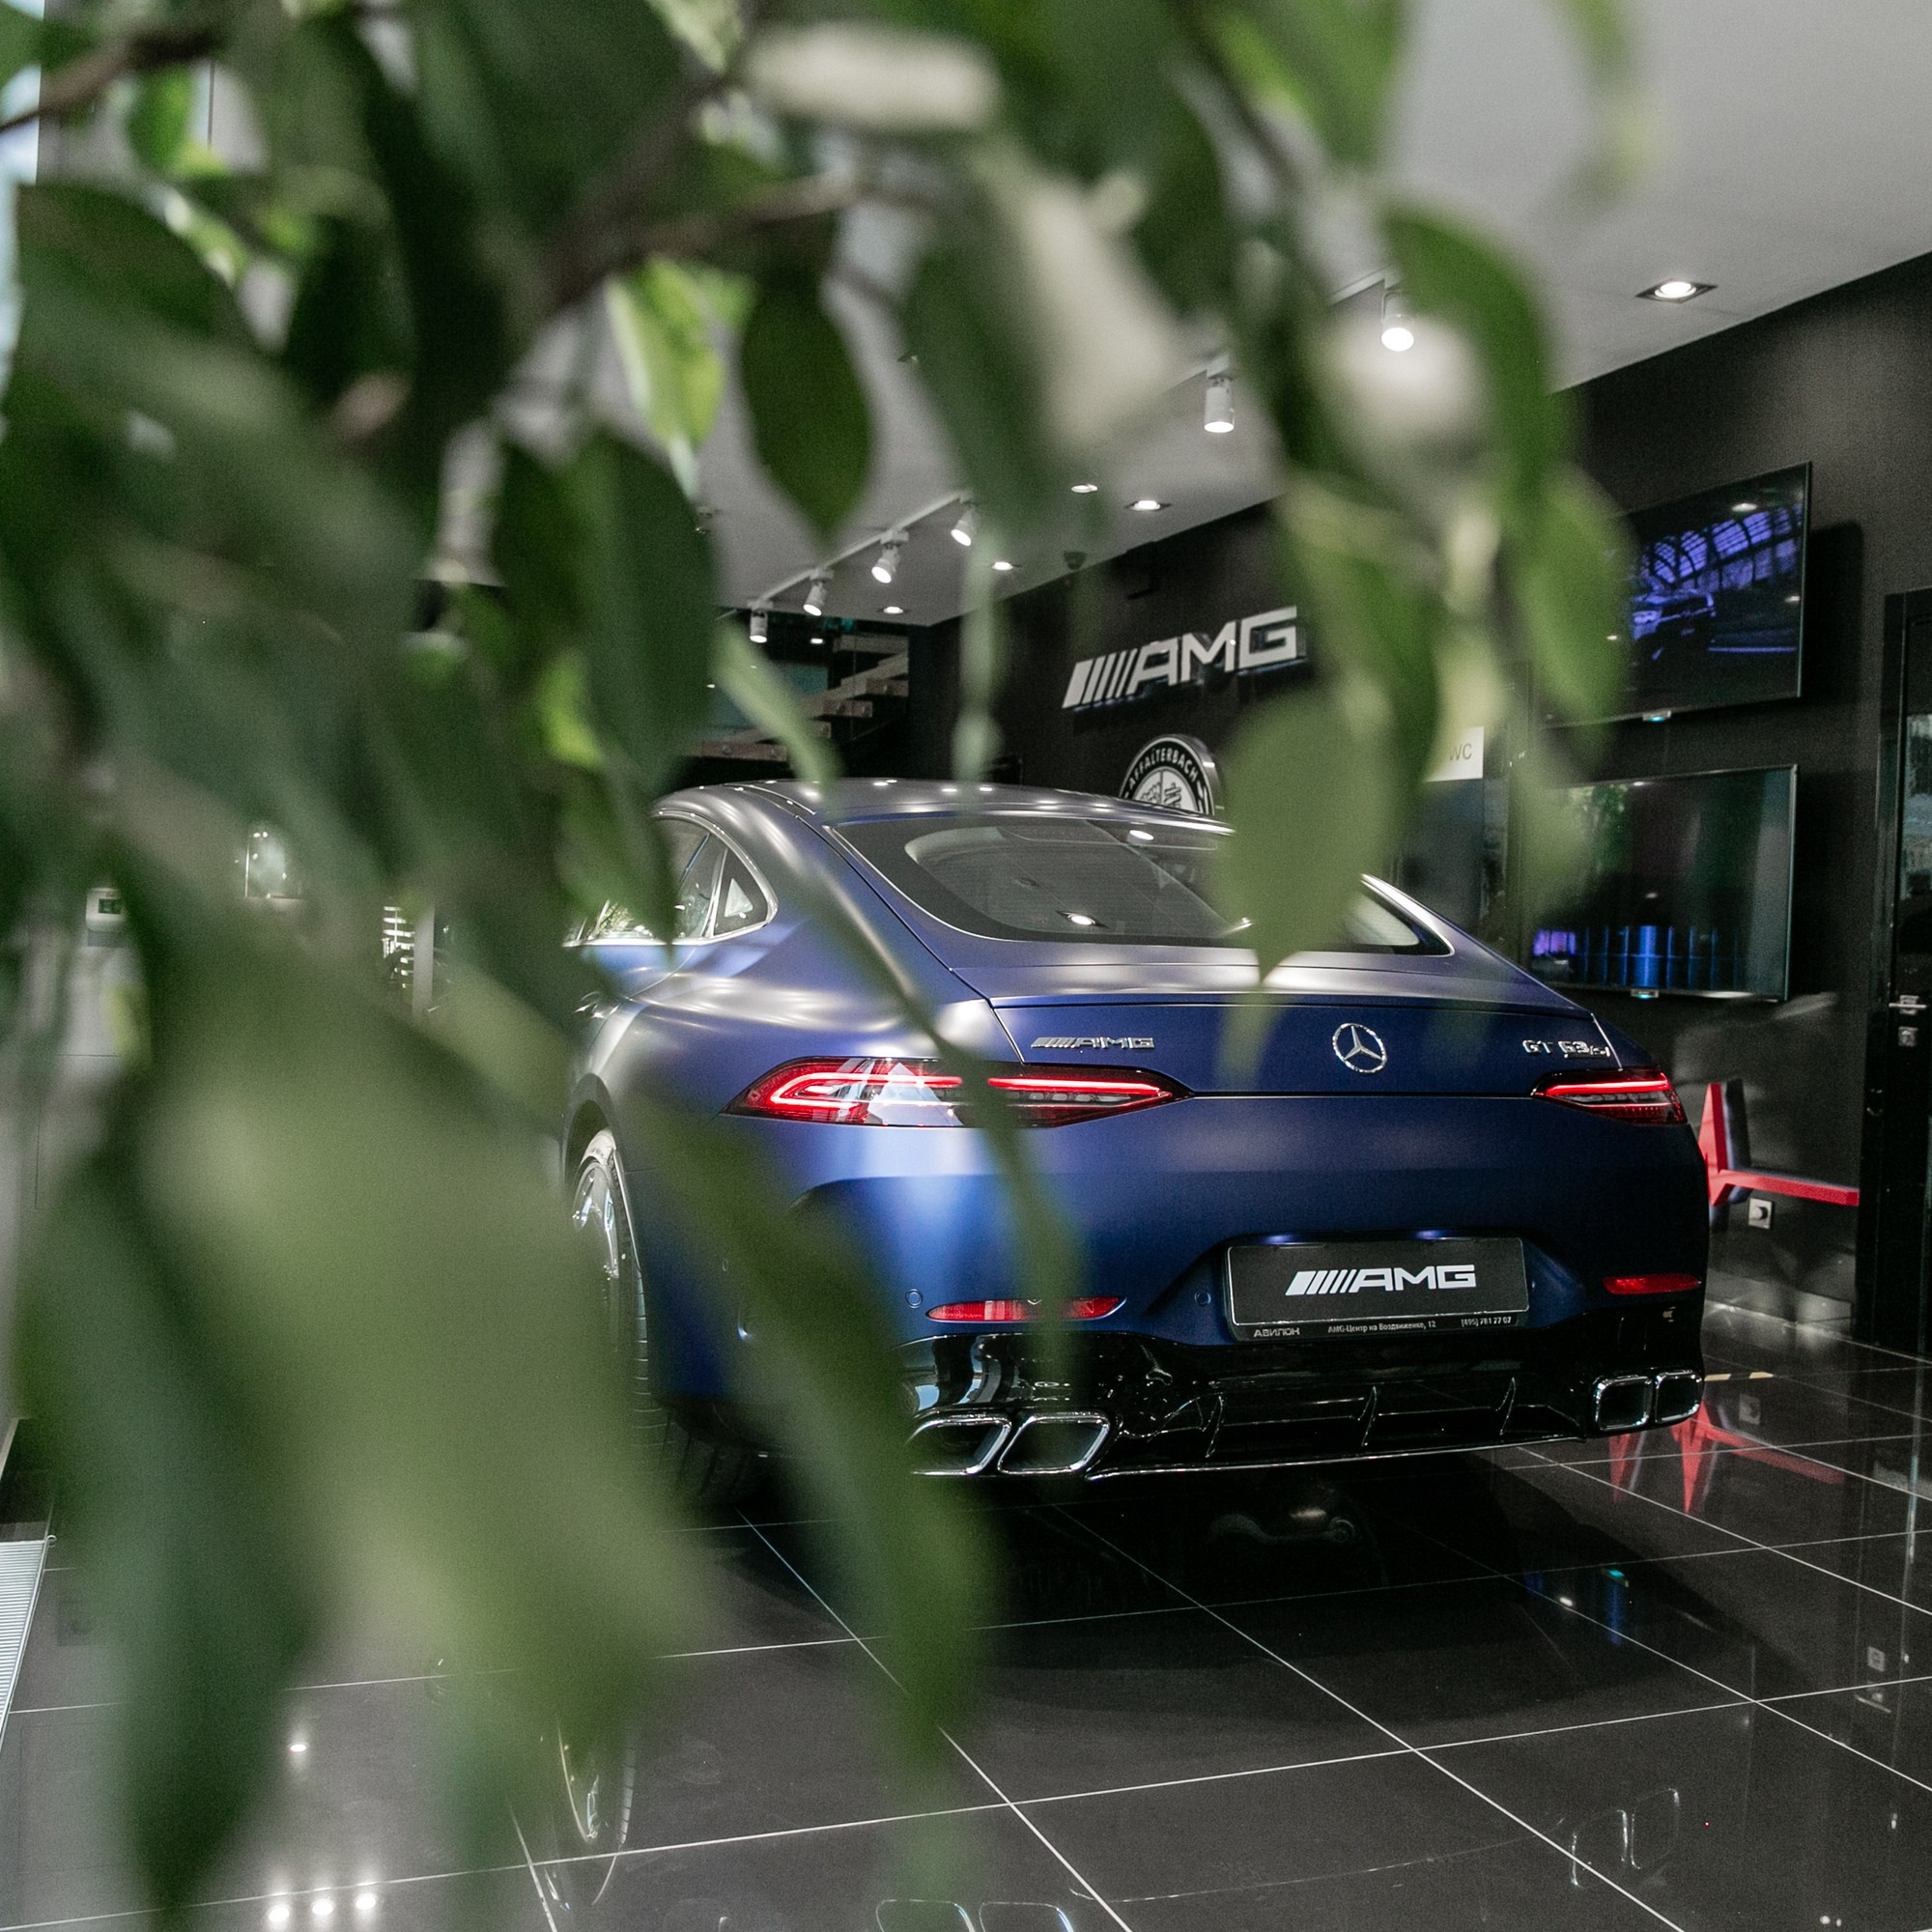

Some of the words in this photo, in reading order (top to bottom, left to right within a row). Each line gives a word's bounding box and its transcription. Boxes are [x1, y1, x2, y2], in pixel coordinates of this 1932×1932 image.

[1124, 606, 1297, 696] AMG
[1128, 747, 1199, 790] AFFALTERBACH
[1069, 1037, 1155, 1049] AMG
[1522, 1039, 1553, 1054] GT
[1348, 1264, 1477, 1293] AMG
[1428, 1320, 1436, 1328] 12
[1502, 1316, 1512, 1324] 07
